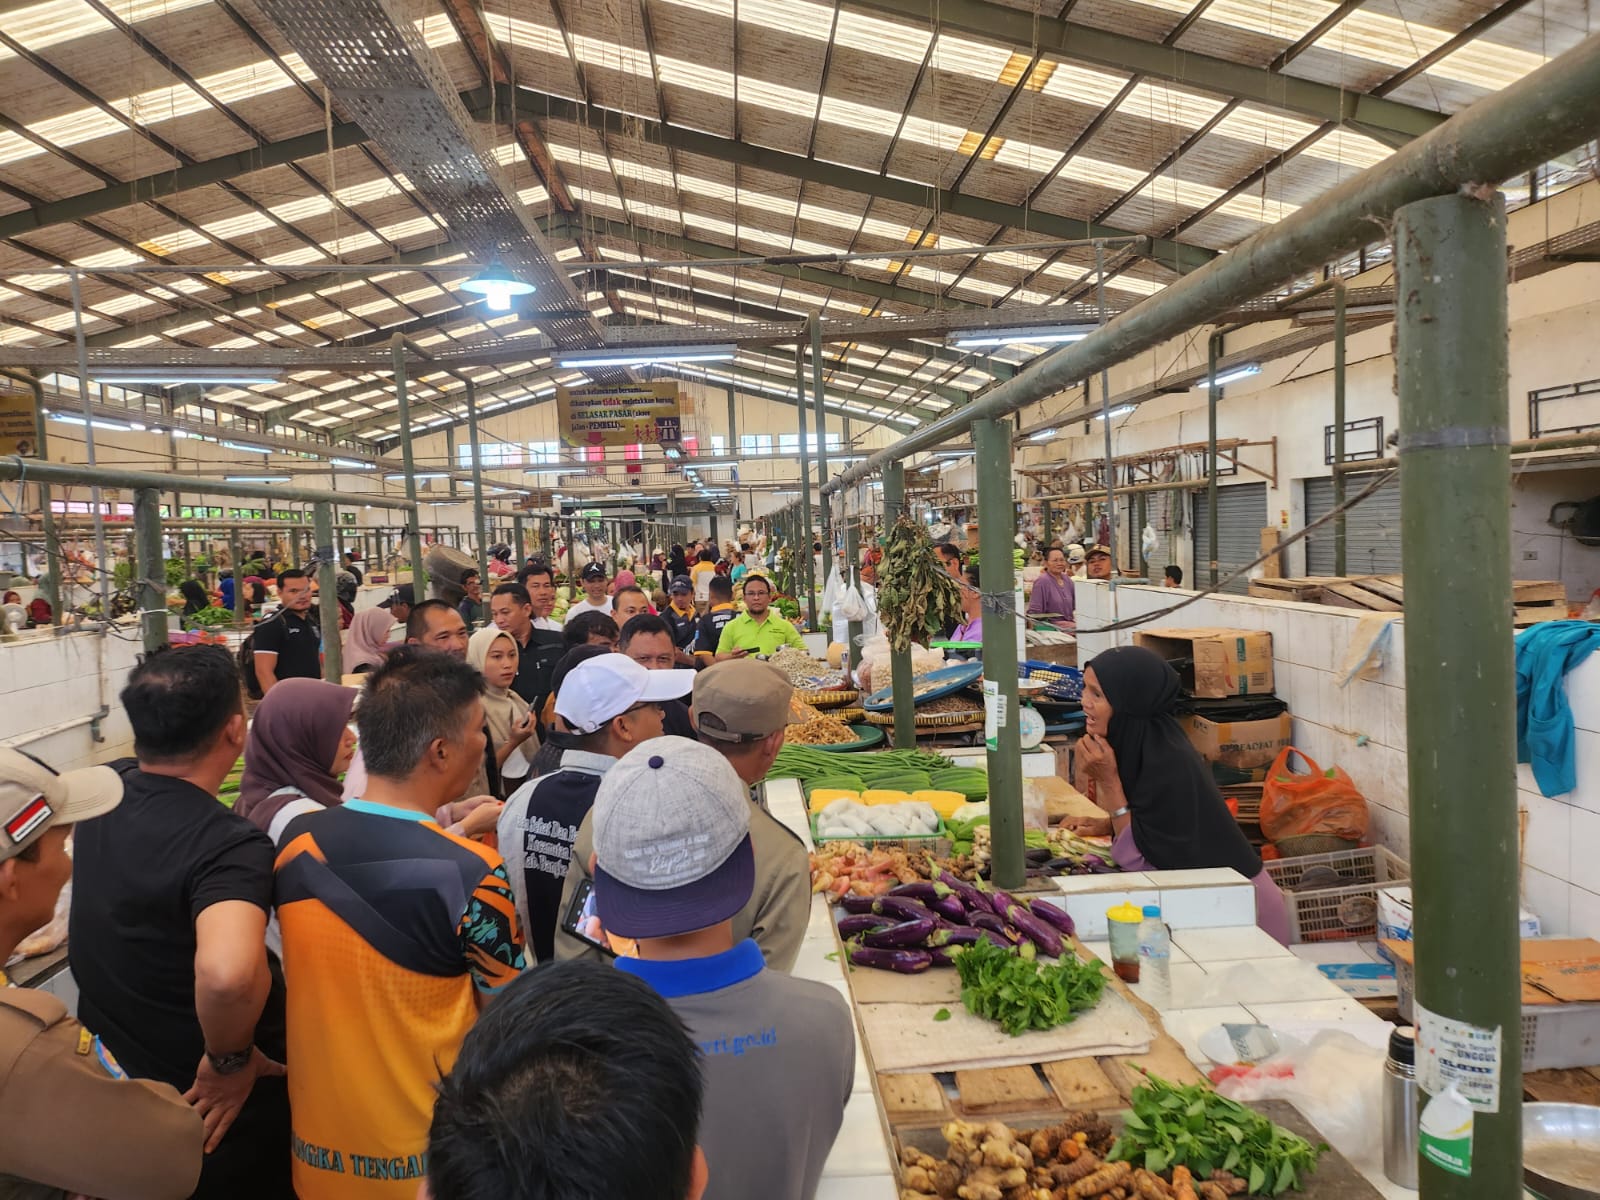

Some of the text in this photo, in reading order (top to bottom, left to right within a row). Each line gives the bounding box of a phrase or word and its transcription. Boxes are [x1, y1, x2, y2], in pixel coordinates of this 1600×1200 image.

[577, 410, 608, 420] SELASAR
[609, 409, 632, 418] PASAR
[291, 1134, 344, 1173] NGKA
